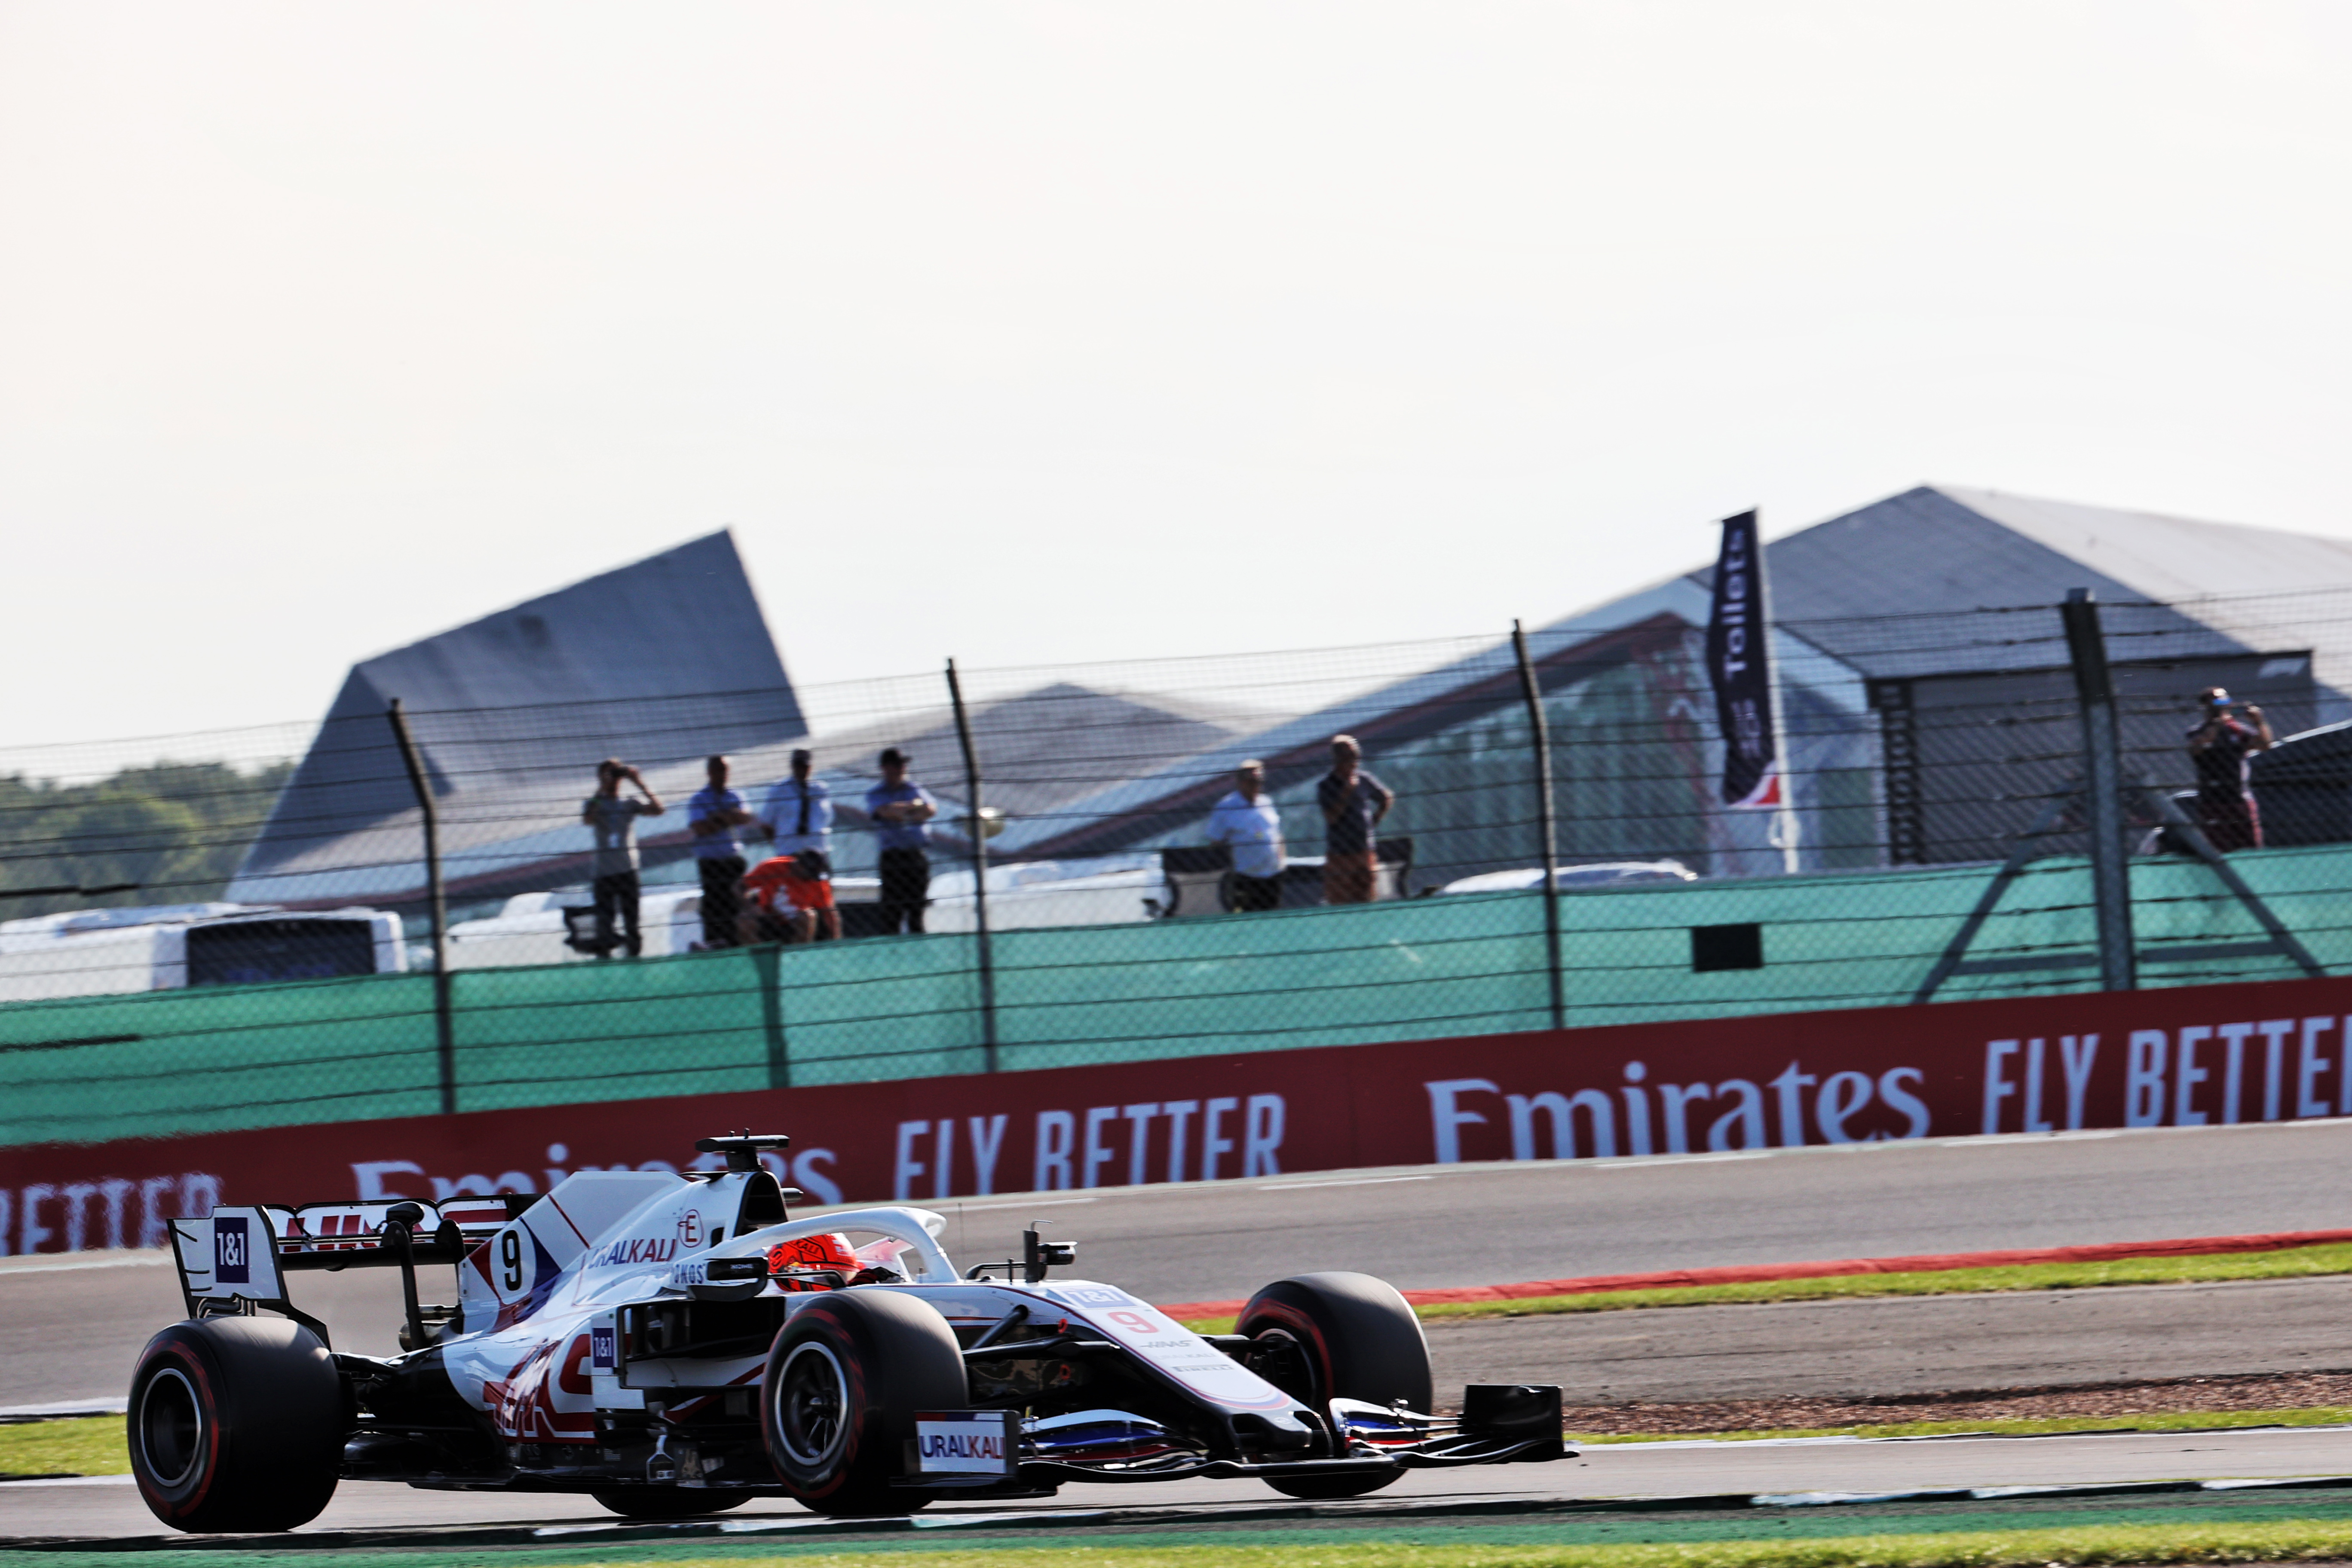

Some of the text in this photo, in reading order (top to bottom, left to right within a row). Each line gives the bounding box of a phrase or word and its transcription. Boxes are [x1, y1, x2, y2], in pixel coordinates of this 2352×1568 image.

[1981, 1032, 2100, 1135] FLY
[1424, 1060, 1931, 1164] Emirates
[894, 1114, 1009, 1200] FLY
[1035, 1093, 1286, 1192] BETTER
[216, 1232, 245, 1266] 1&1
[502, 1230, 521, 1291] 9
[1068, 1290, 1120, 1303] 1&1
[1107, 1311, 1160, 1334] 9
[594, 1337, 612, 1357] 1&1
[919, 1435, 1005, 1459] URALKALI
